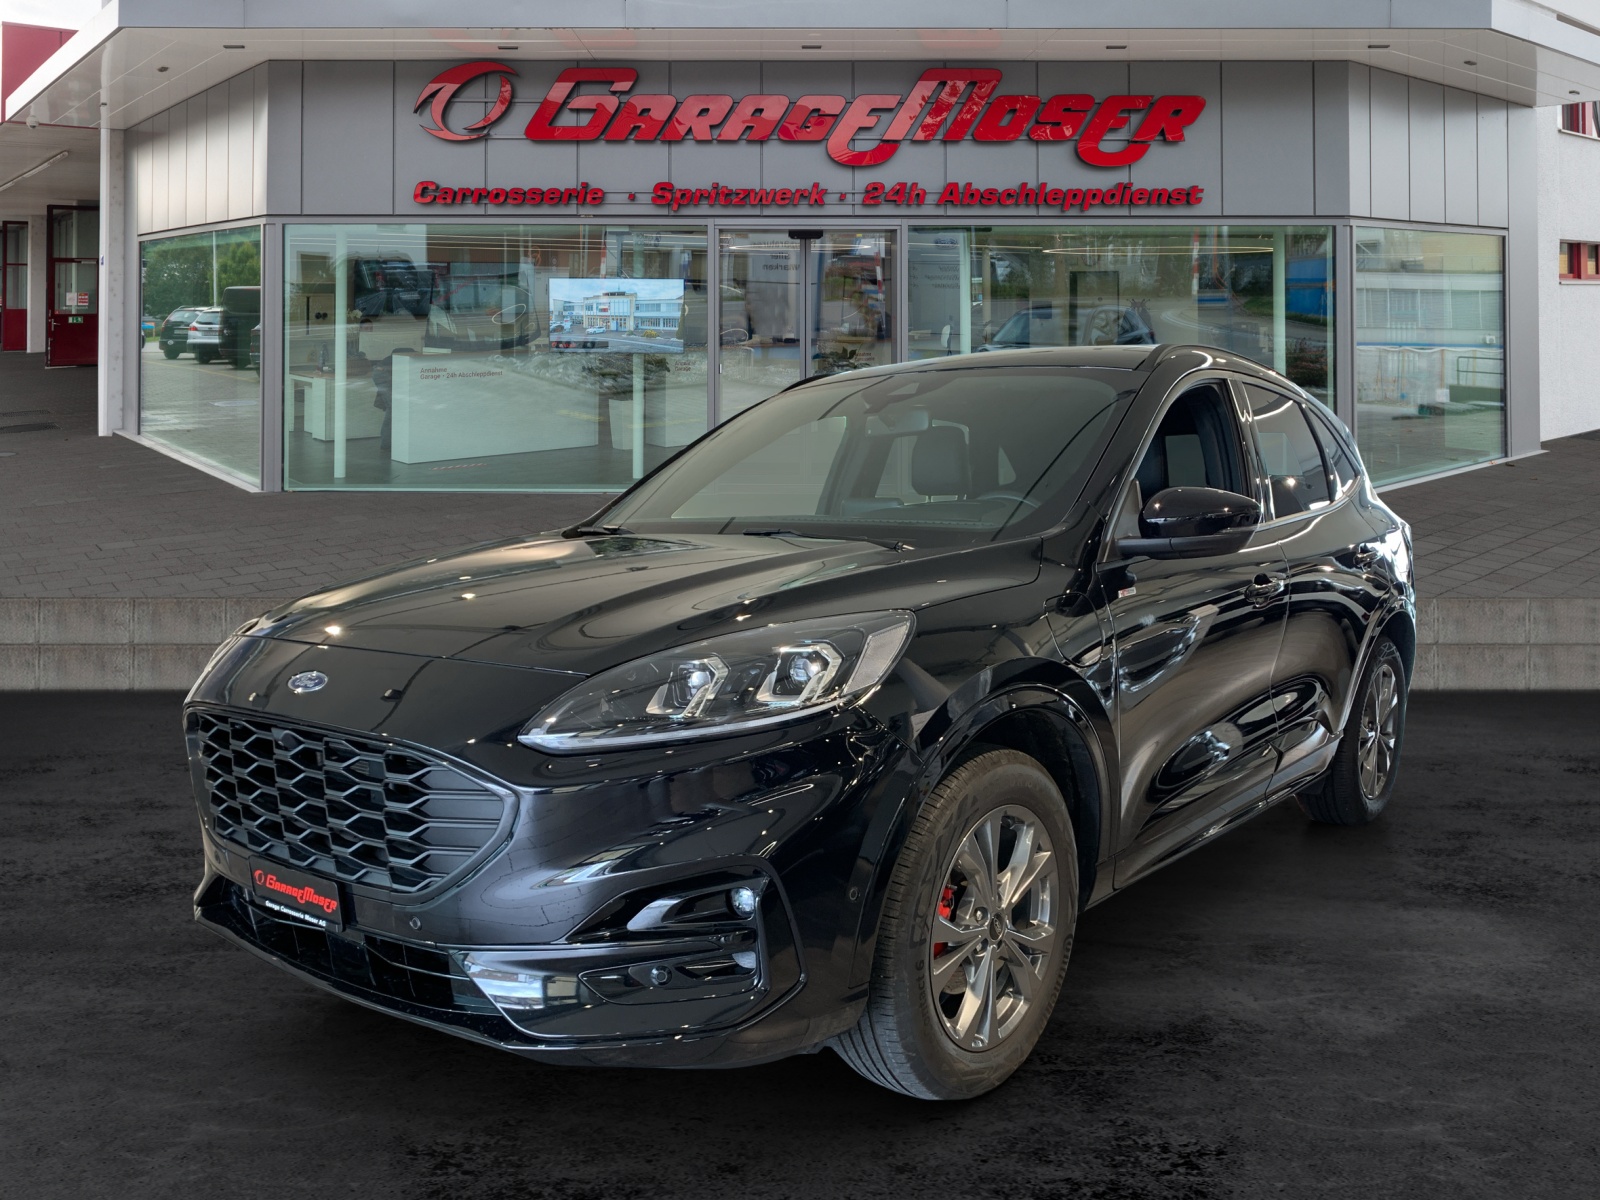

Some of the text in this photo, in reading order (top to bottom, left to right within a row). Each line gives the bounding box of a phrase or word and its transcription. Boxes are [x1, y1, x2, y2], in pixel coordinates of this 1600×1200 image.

[413, 181, 1204, 211] Carrosserie Spritzwerk 24h Abschleppdienst
[458, 370, 503, 378] Abschleppdienst
